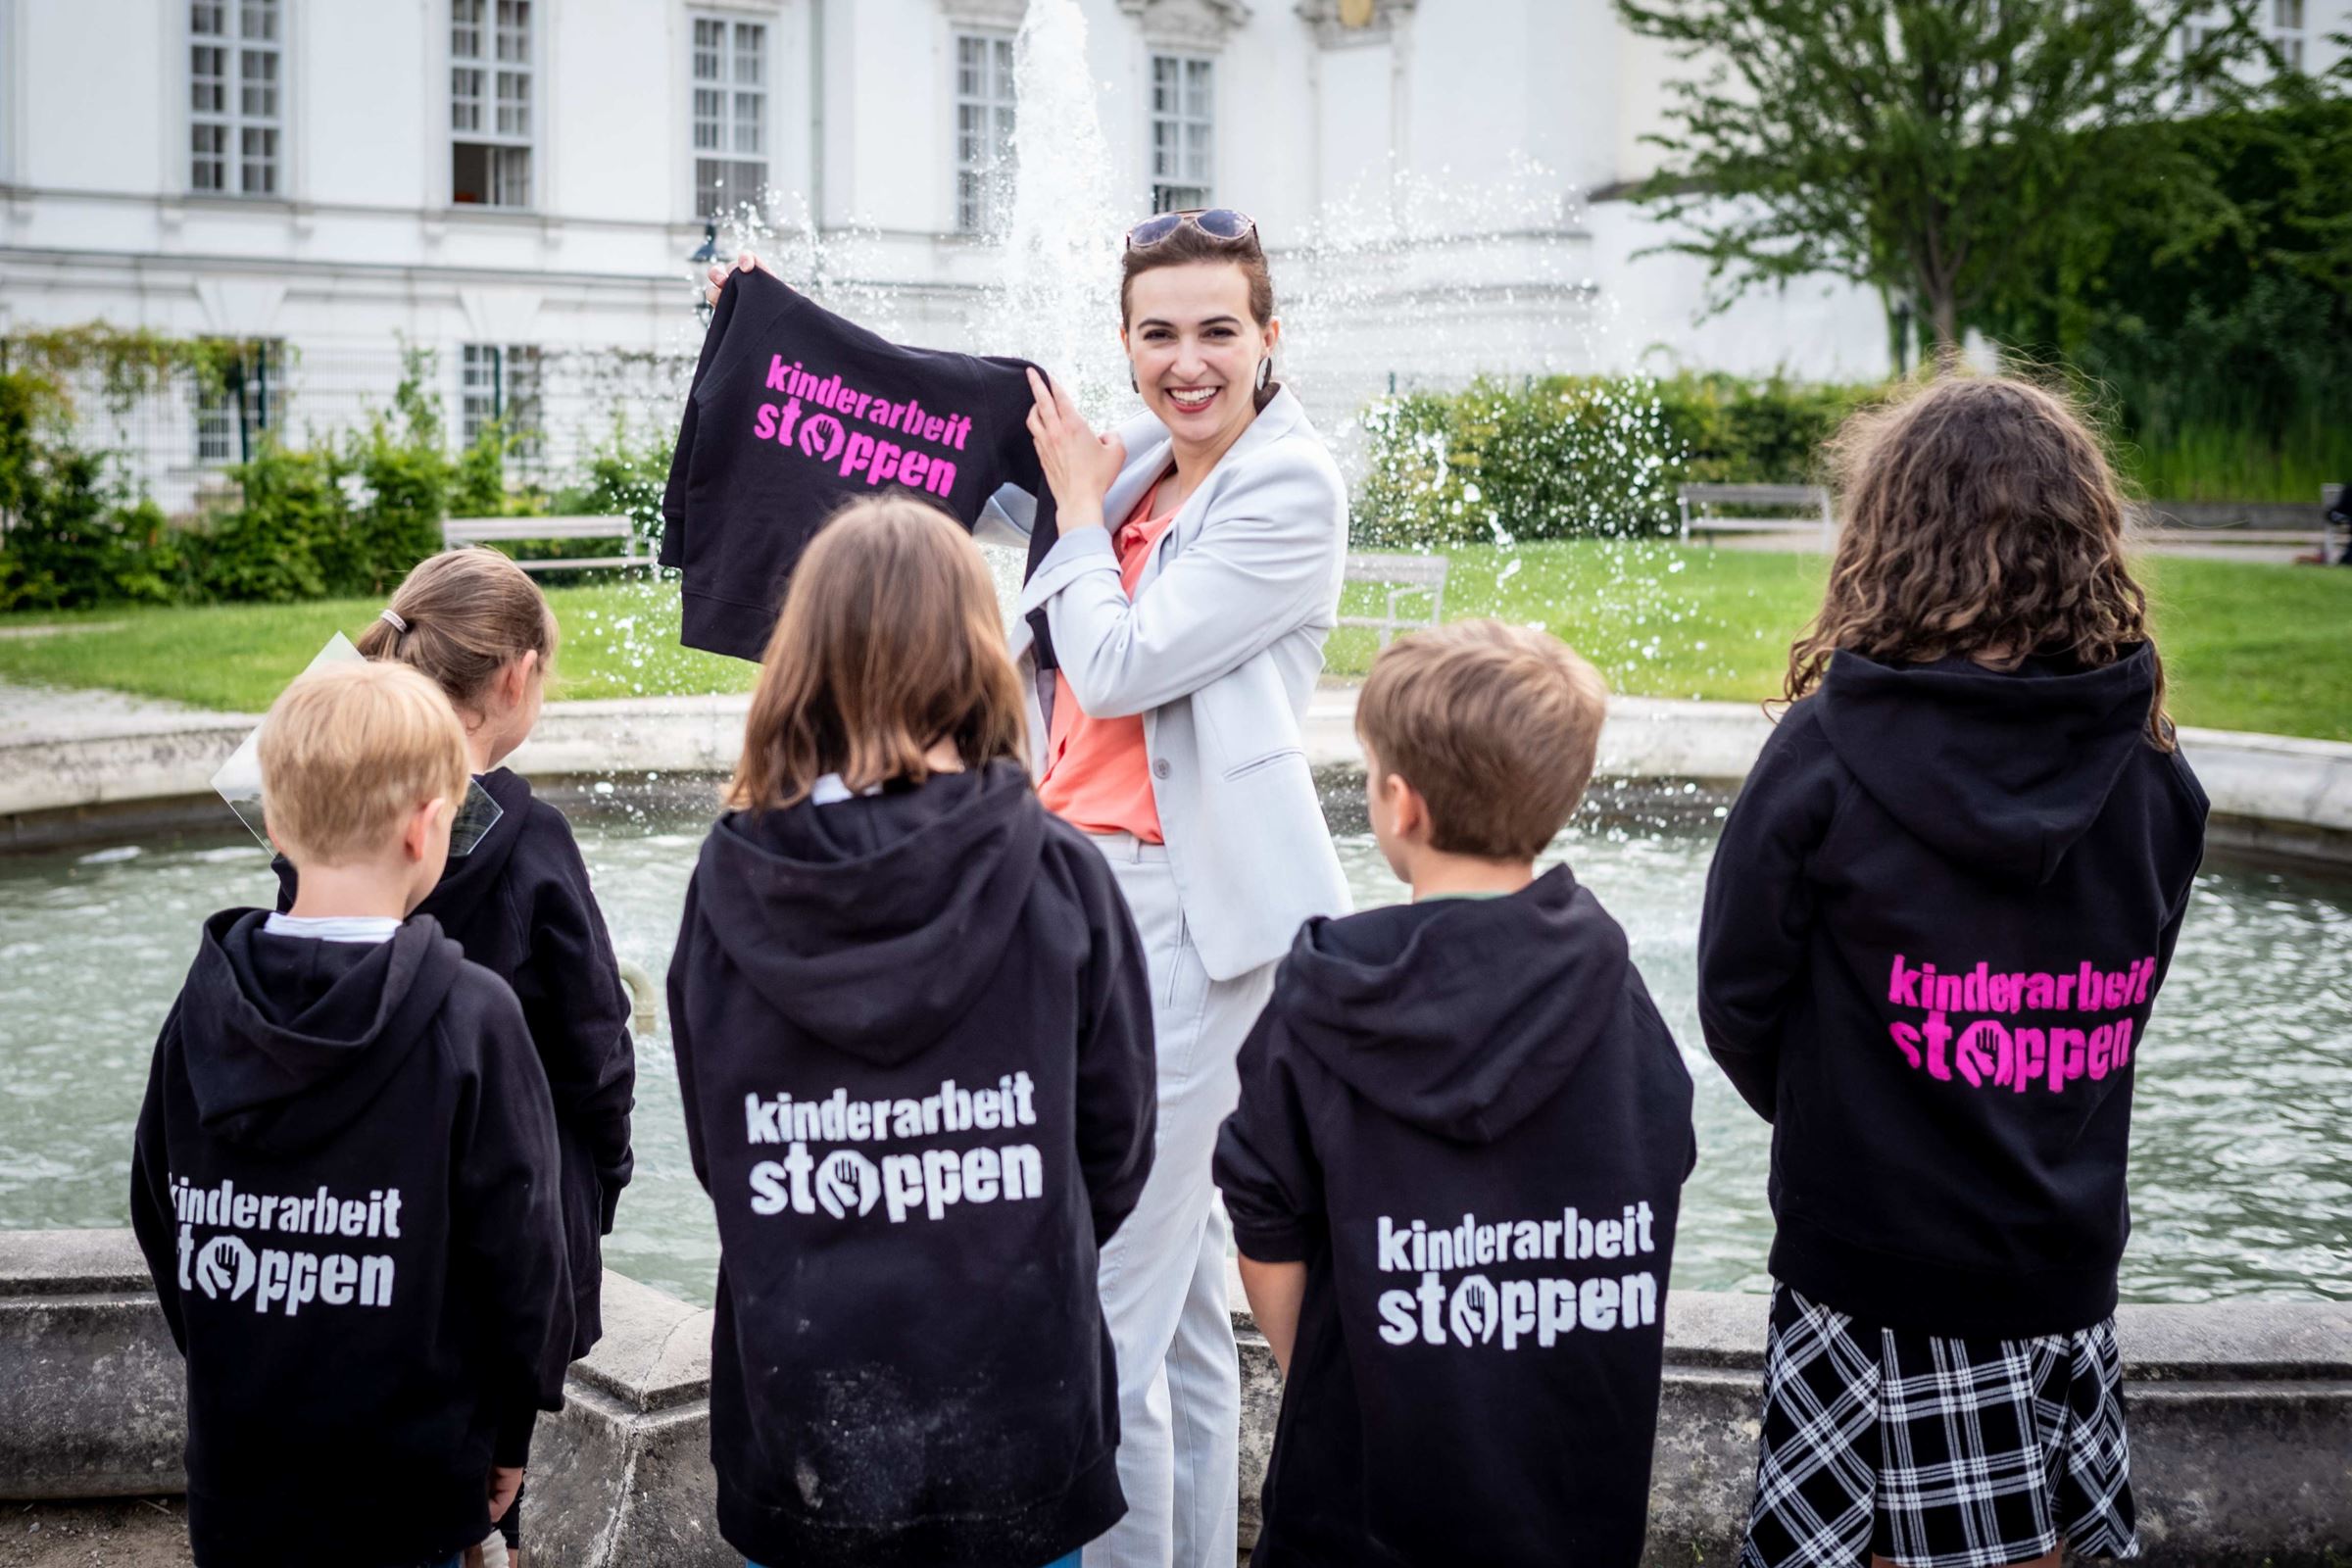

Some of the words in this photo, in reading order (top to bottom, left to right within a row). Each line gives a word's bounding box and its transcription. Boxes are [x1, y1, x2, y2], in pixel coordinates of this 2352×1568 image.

[765, 354, 972, 451] kinderarbeit
[754, 396, 957, 498] stoppen
[1888, 955, 2155, 1014] kinderarbeit
[1888, 1010, 2133, 1093] stoppen
[745, 1070, 1037, 1145] kinderarbeit
[750, 1142, 1043, 1223] stoppen
[177, 1224, 395, 1316] toppen
[1377, 1200, 1655, 1272] kinderarbeit
[1377, 1271, 1657, 1350] stoppen
